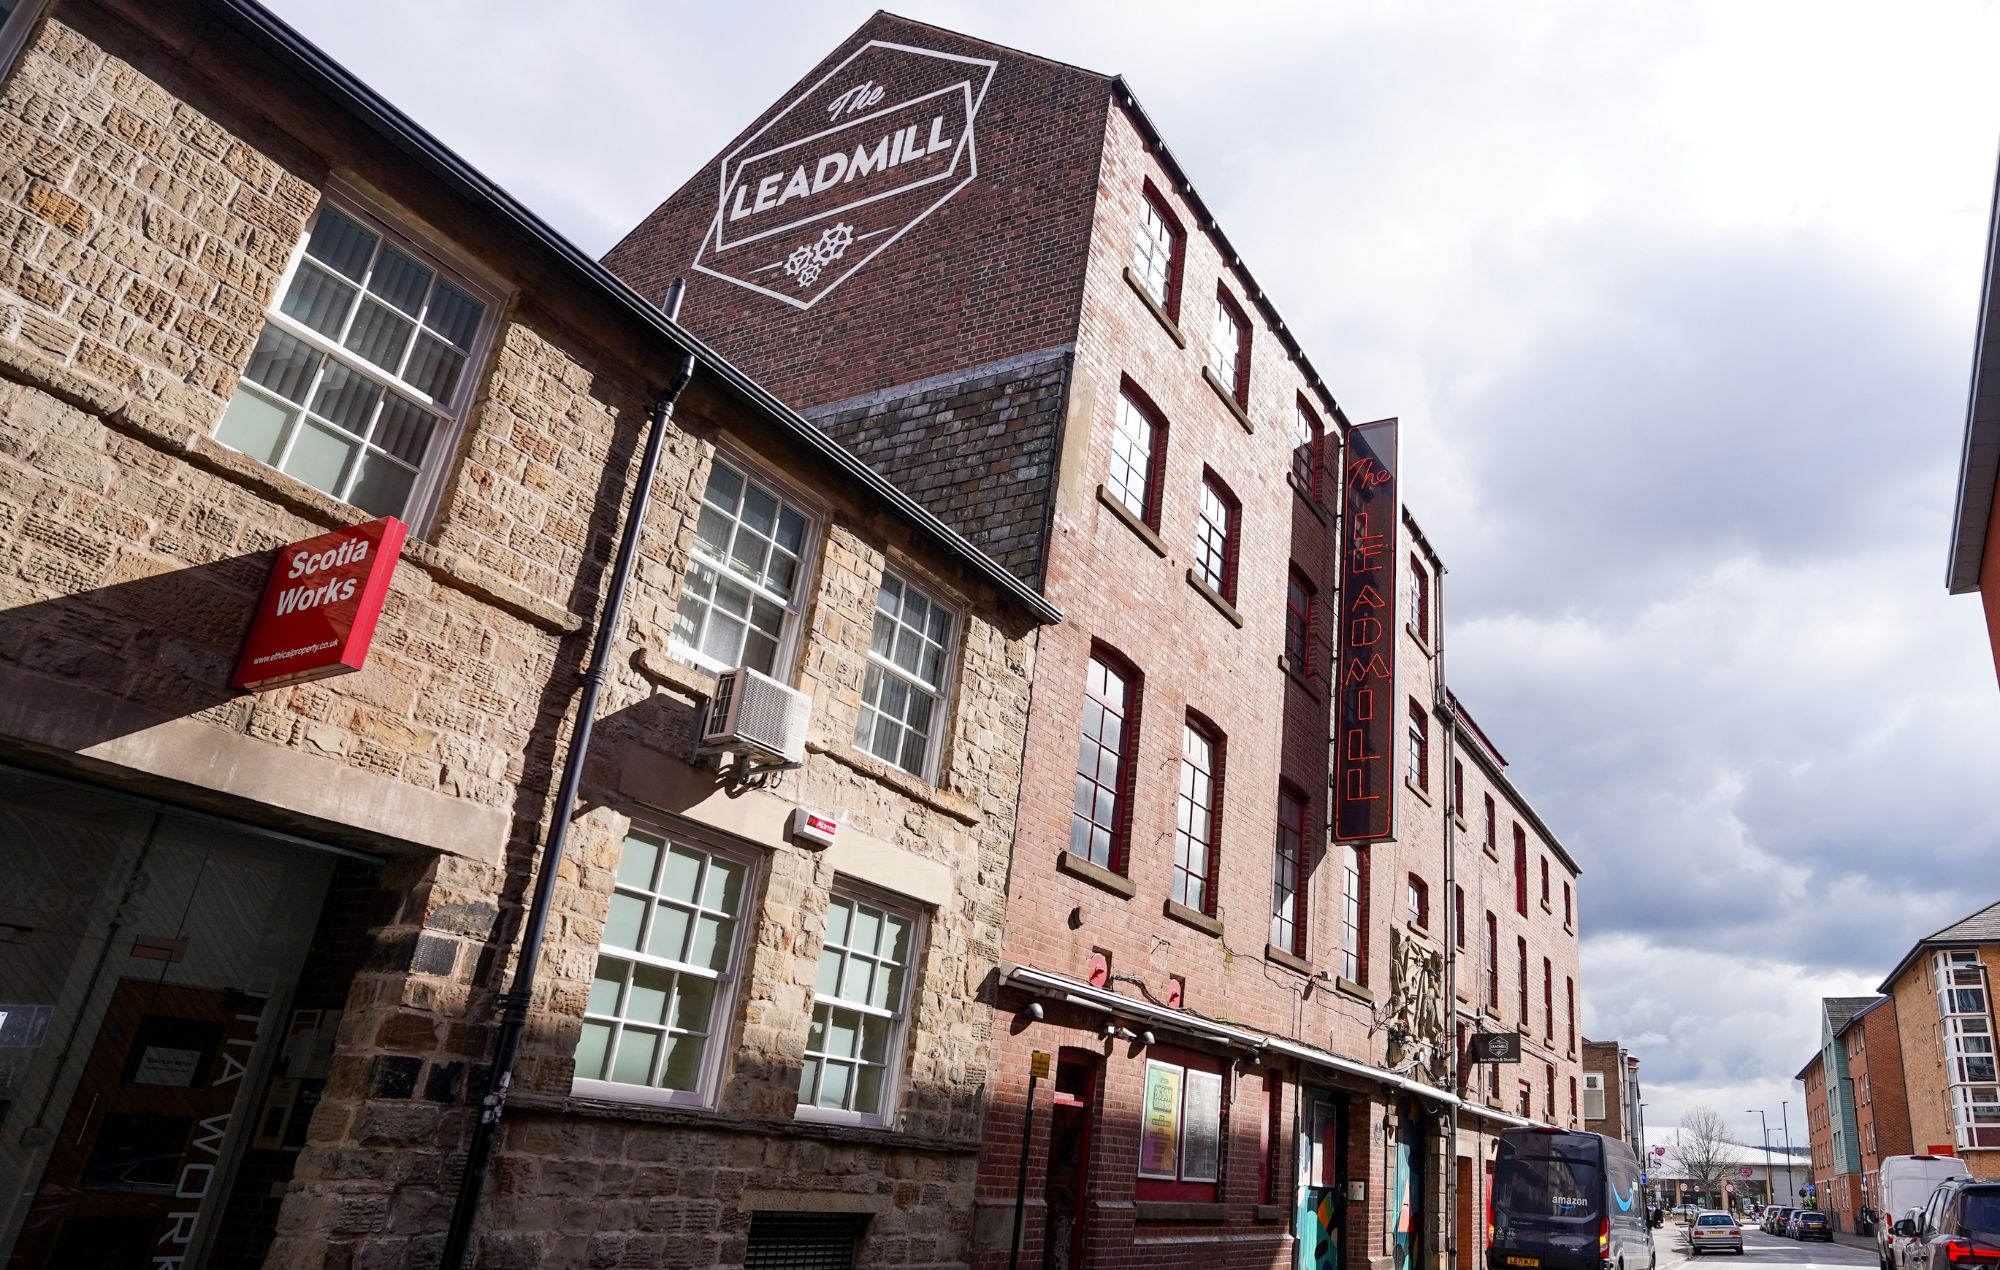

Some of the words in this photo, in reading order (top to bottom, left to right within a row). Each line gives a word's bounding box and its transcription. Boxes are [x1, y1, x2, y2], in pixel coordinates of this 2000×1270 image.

[828, 80, 885, 122] The
[729, 115, 953, 222] LEADMILL
[1348, 457, 1391, 488] The
[288, 537, 369, 579] Scotia
[276, 577, 356, 615] Works
[253, 638, 339, 664] www.ethicalproperty.co.uk
[1345, 512, 1390, 801] LEADMILL
[1552, 1195, 1588, 1206] amazon
